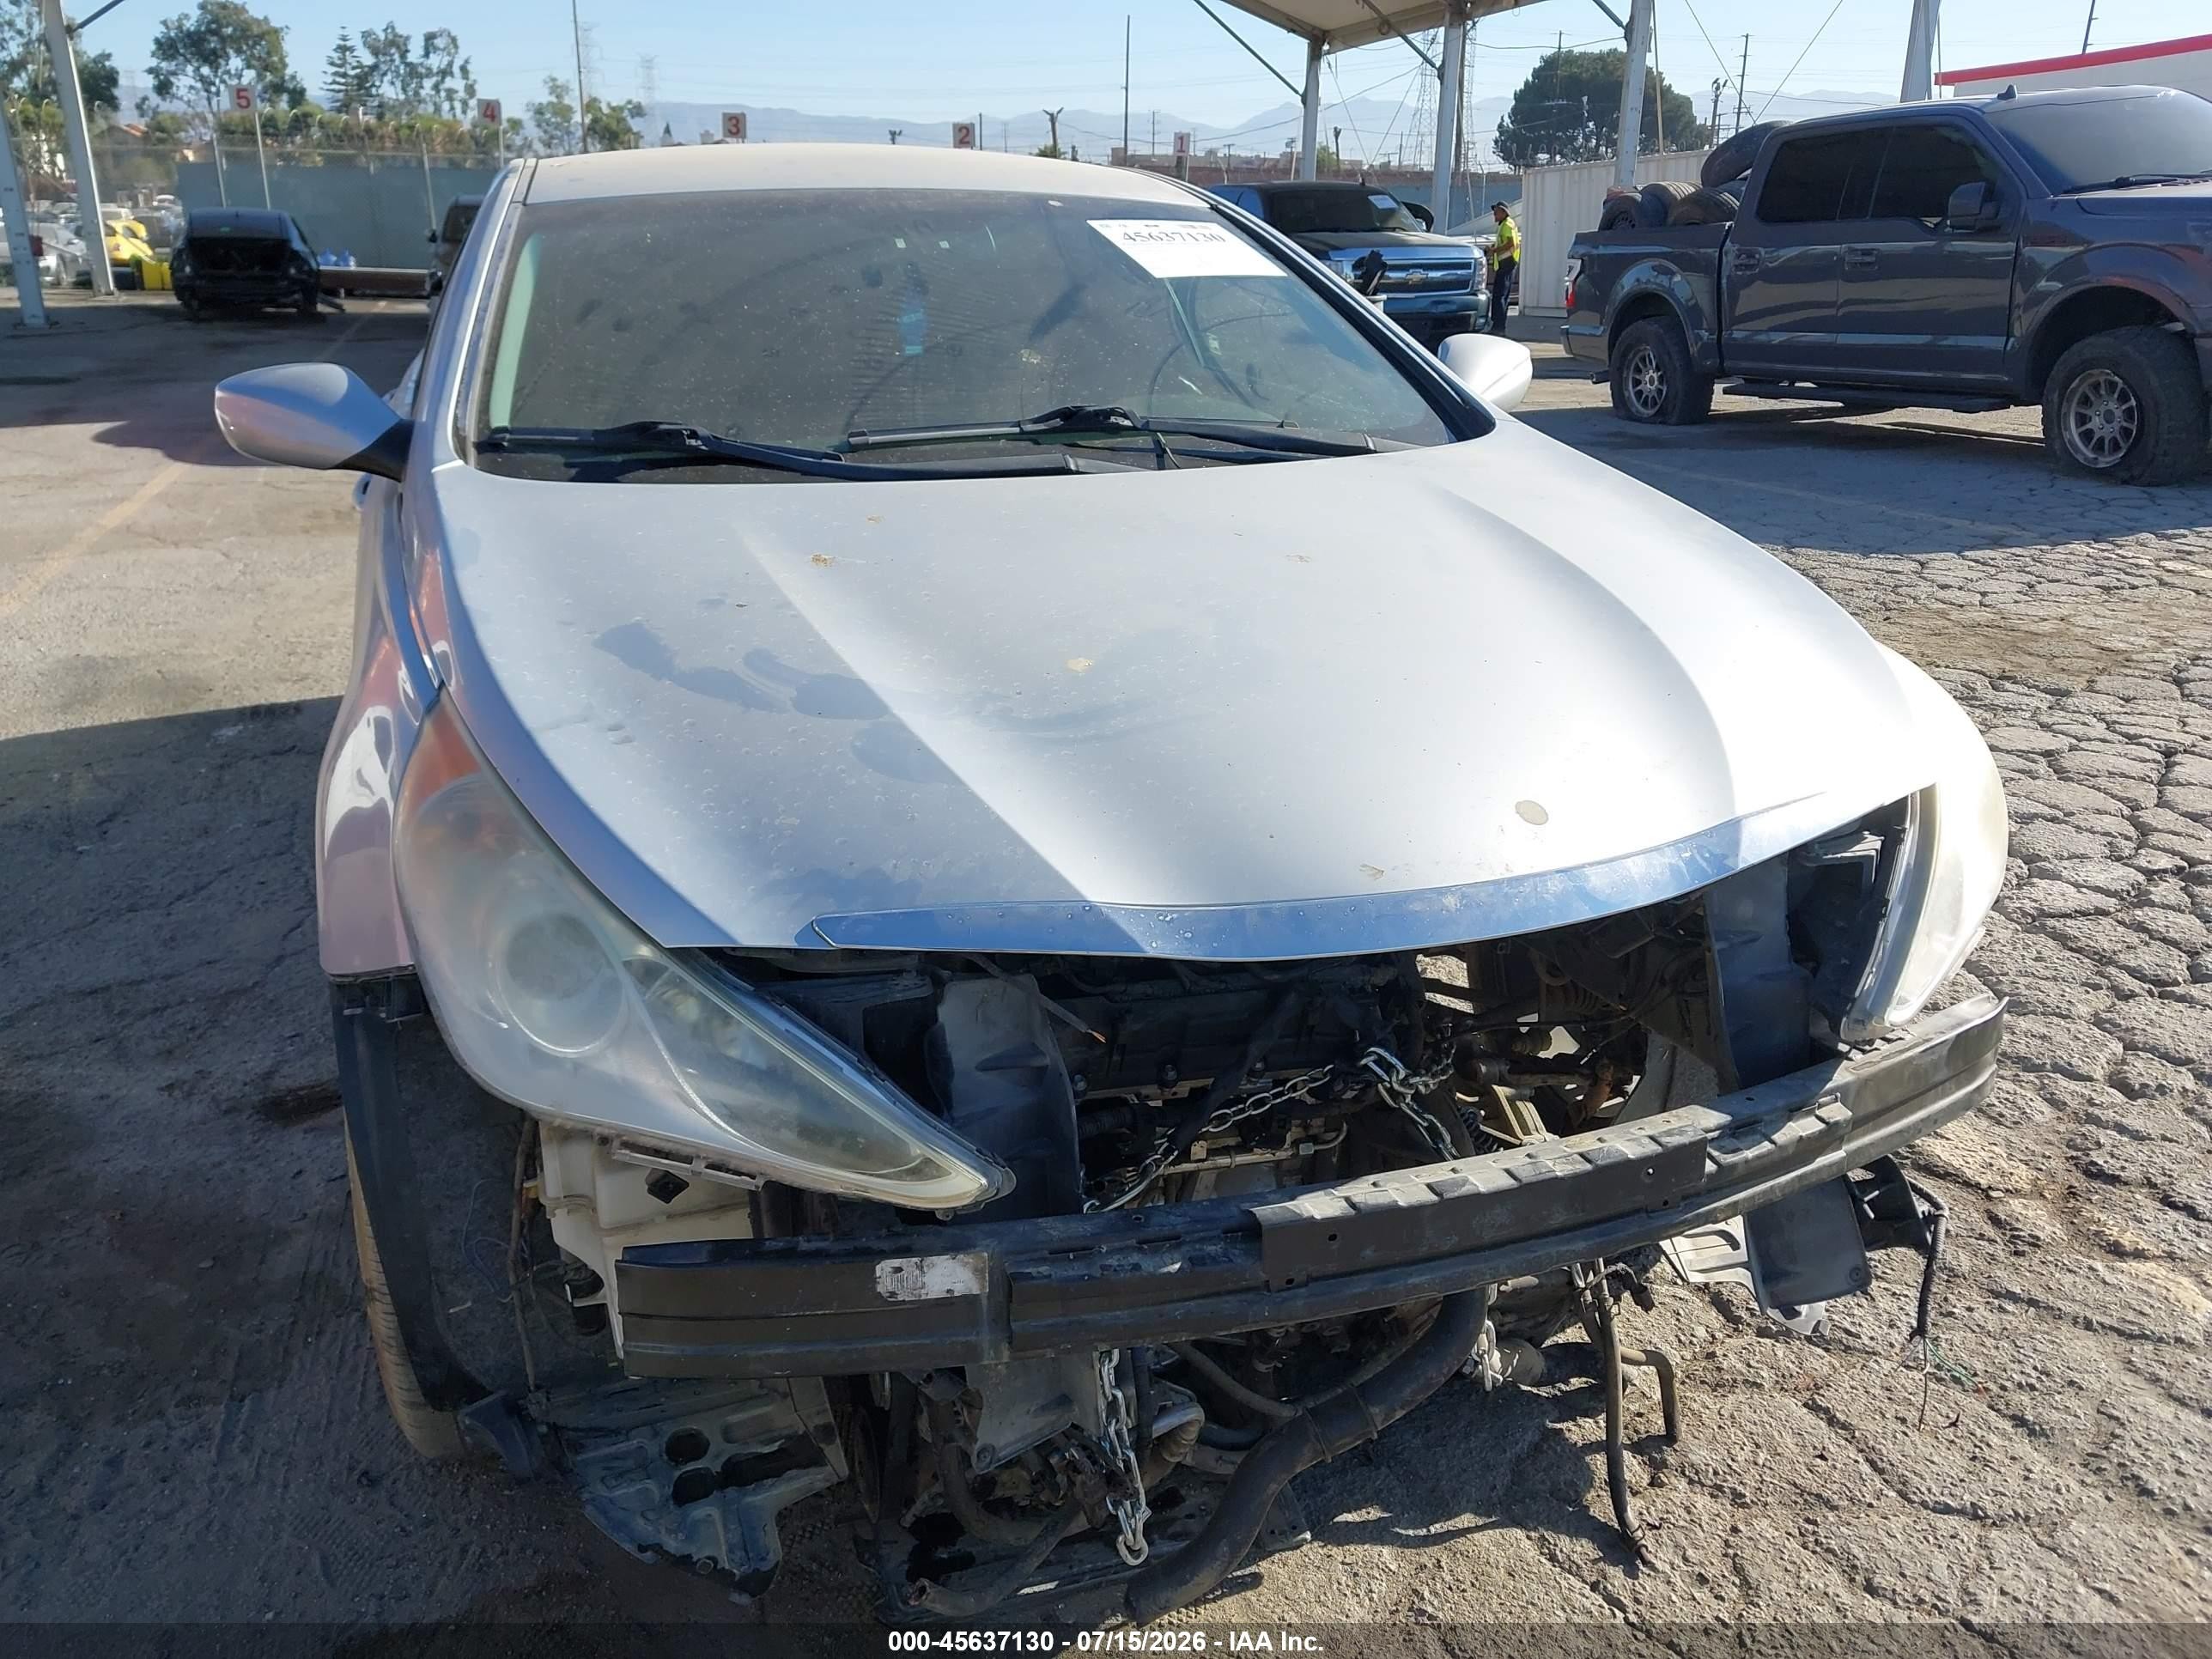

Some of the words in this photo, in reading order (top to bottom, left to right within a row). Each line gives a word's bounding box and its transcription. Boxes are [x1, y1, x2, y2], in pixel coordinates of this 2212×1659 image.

[235, 88, 251, 110] 5
[483, 103, 495, 123] 4
[727, 116, 740, 136] 3
[957, 125, 970, 145] 2
[1176, 136, 1186, 153] 1
[1123, 232, 1226, 242] 45637130
